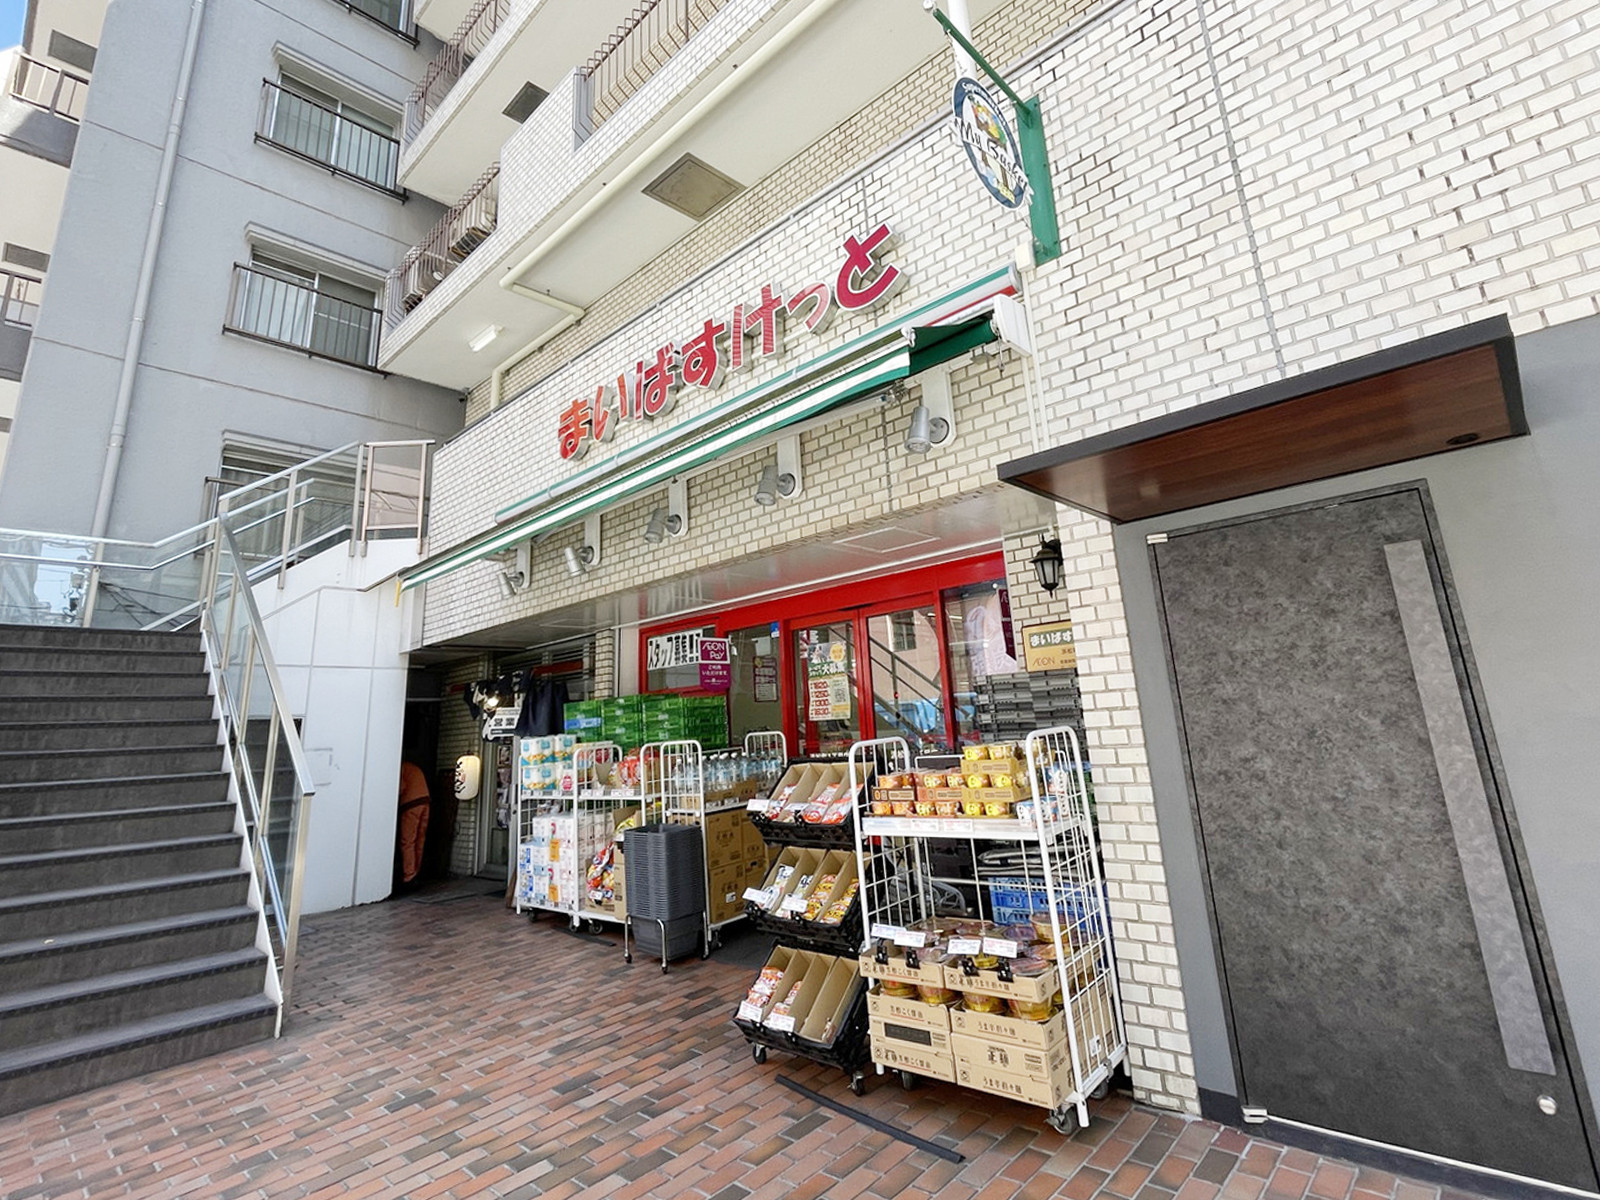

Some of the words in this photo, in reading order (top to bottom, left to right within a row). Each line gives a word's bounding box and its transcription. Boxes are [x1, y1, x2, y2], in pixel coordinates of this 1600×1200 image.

[987, 137, 1028, 191] Basket
[557, 222, 902, 460] まいばすけっと
